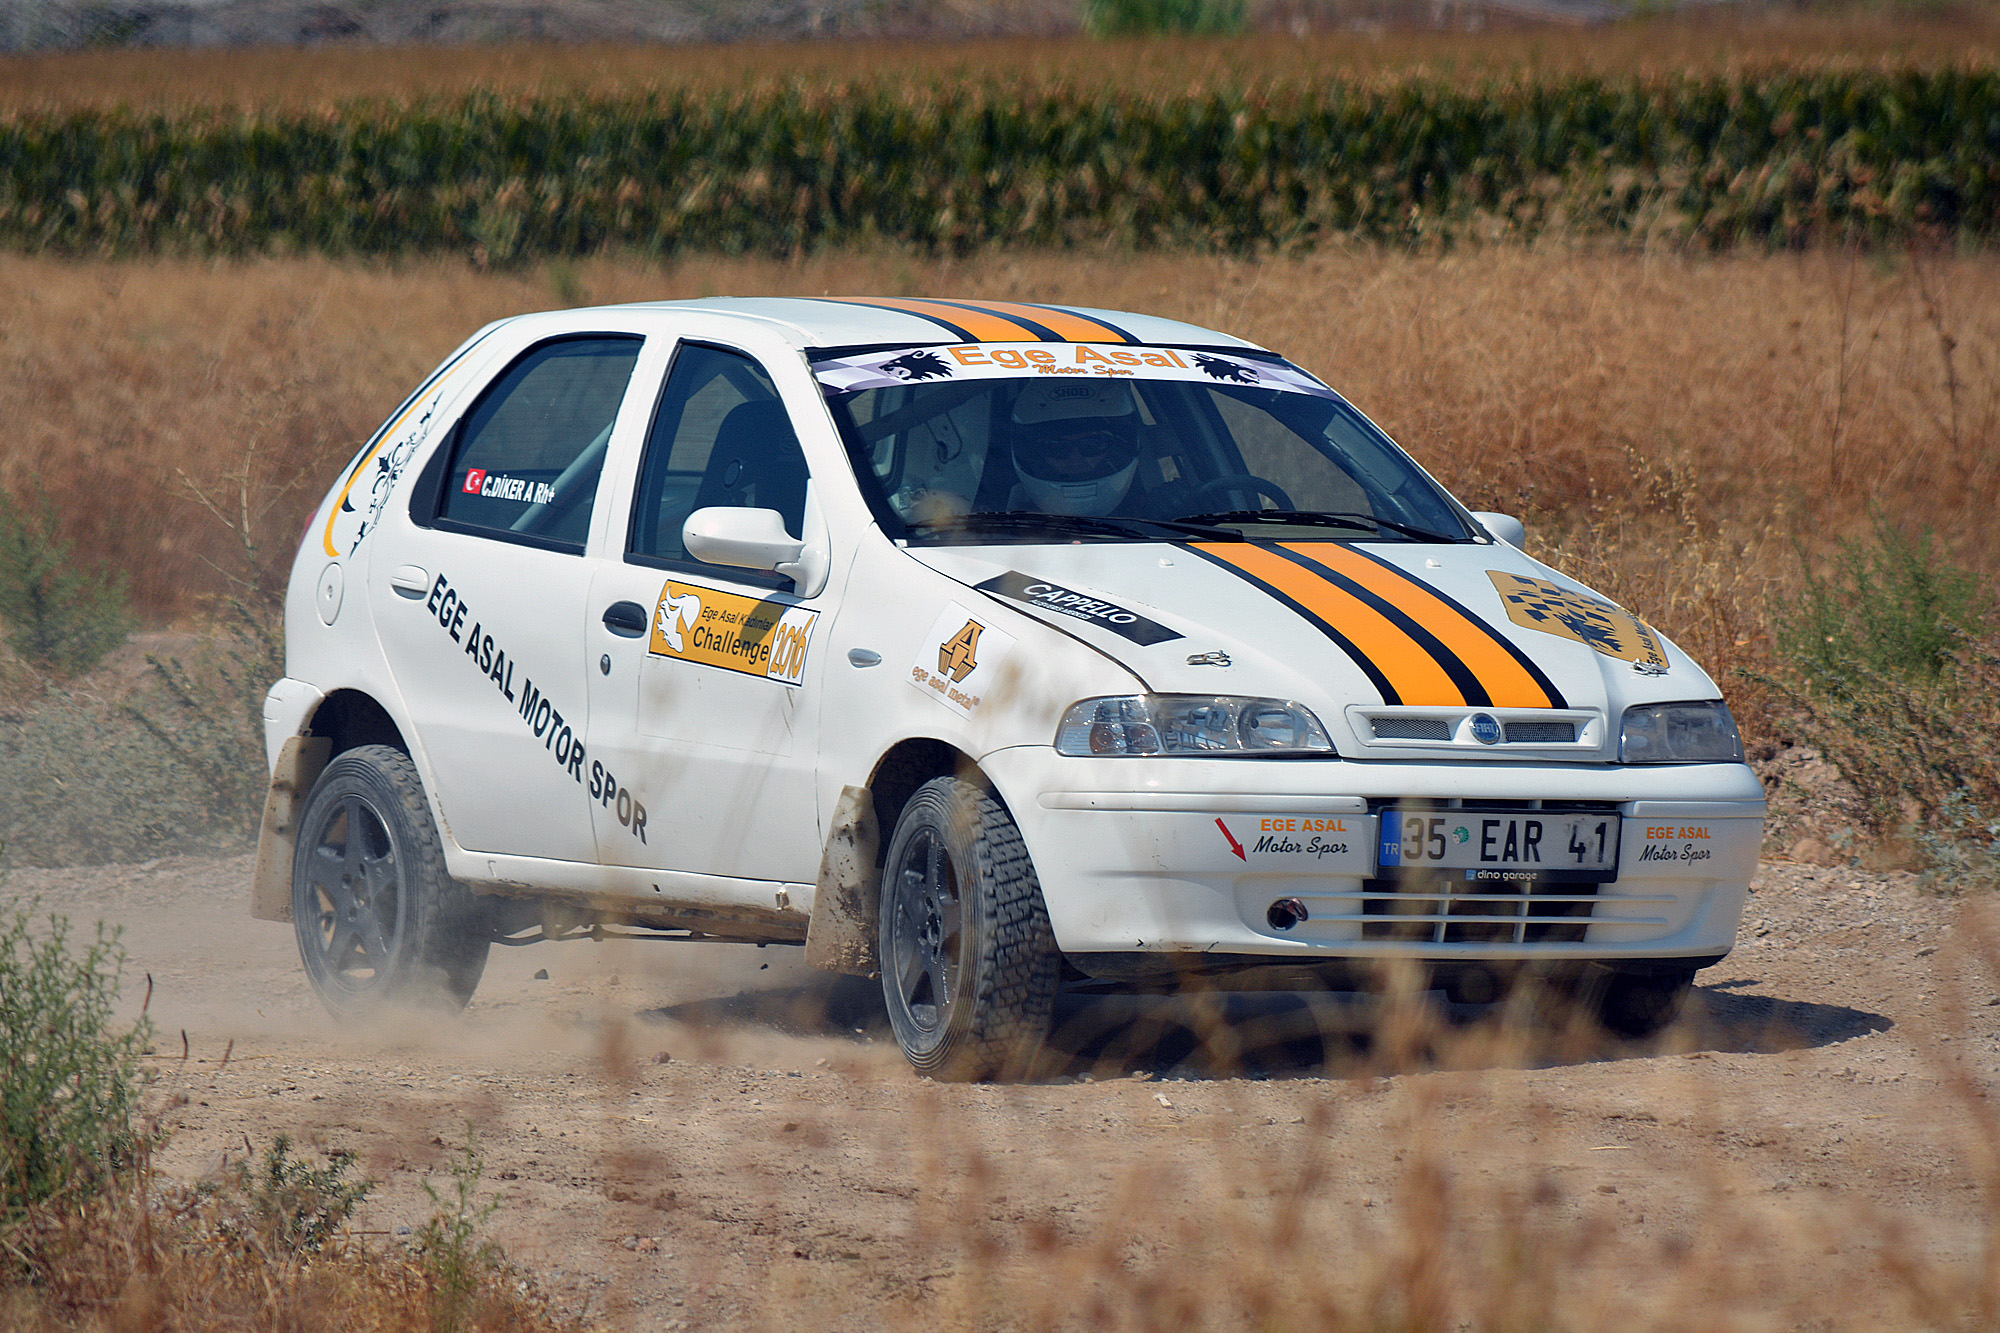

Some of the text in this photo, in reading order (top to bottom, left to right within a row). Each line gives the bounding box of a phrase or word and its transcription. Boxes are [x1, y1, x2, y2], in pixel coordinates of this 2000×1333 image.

[947, 345, 1189, 369] Ege Asal
[1032, 364, 1135, 378] Motor Spor
[522, 481, 535, 502] A
[701, 606, 719, 622] Ege
[718, 609, 737, 624] Asal
[1023, 584, 1137, 624] CAPPELLO
[693, 626, 770, 665] Challenge
[769, 614, 815, 679] 2016
[912, 666, 929, 682] ege
[928, 675, 951, 695] asal
[427, 573, 648, 846] EGE ASAL MOTOR SPOR
[1475, 722, 1496, 735] FIAT
[1260, 818, 1347, 832] EGE ASAL
[1646, 826, 1711, 840] EGE ASAL
[1252, 835, 1349, 860] Motor Spor
[1383, 817, 1607, 863] TR 35 EAR 41
[1638, 843, 1711, 867] Motor Spor
[1477, 869, 1538, 881] dino garage
